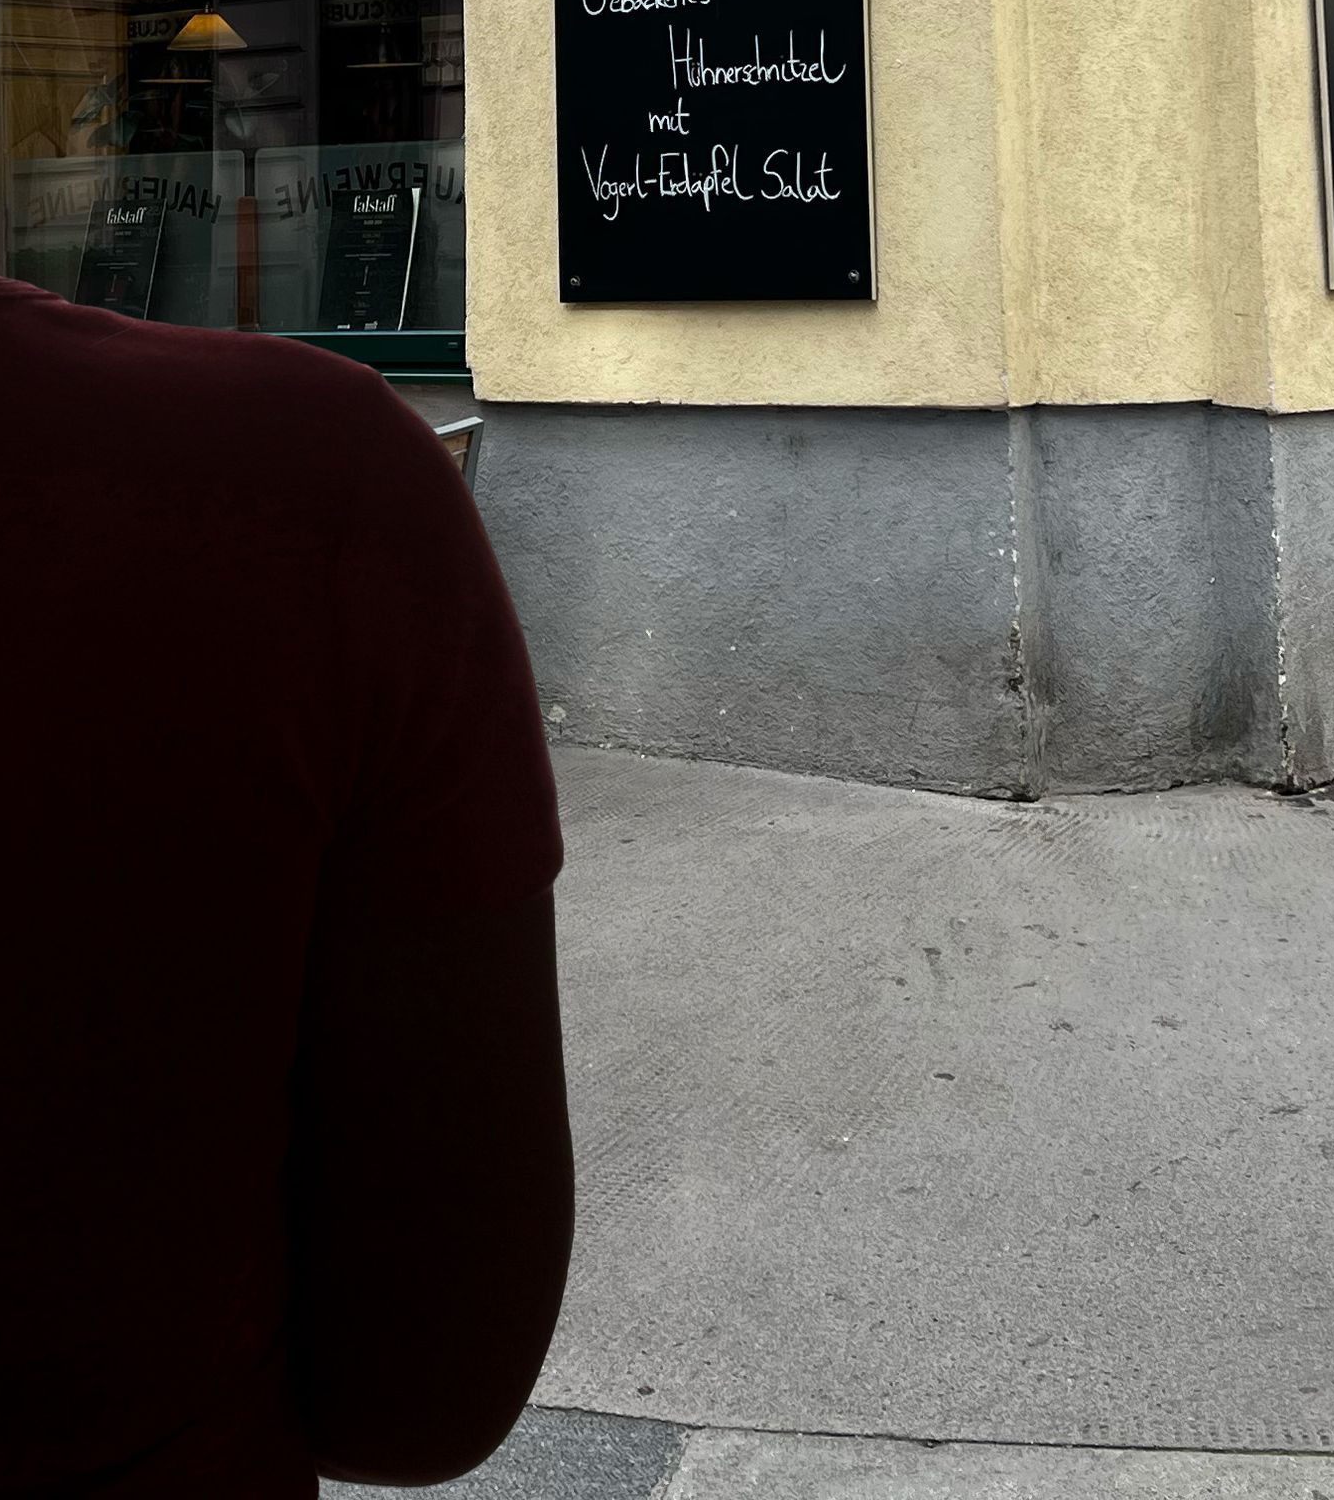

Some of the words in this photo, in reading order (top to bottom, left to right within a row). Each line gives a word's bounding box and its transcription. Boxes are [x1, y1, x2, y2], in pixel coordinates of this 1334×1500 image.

[649, 97, 690, 135] mit
[760, 148, 841, 203] Salat
[106, 206, 149, 225] falstaff
[352, 193, 398, 213] falstaff
